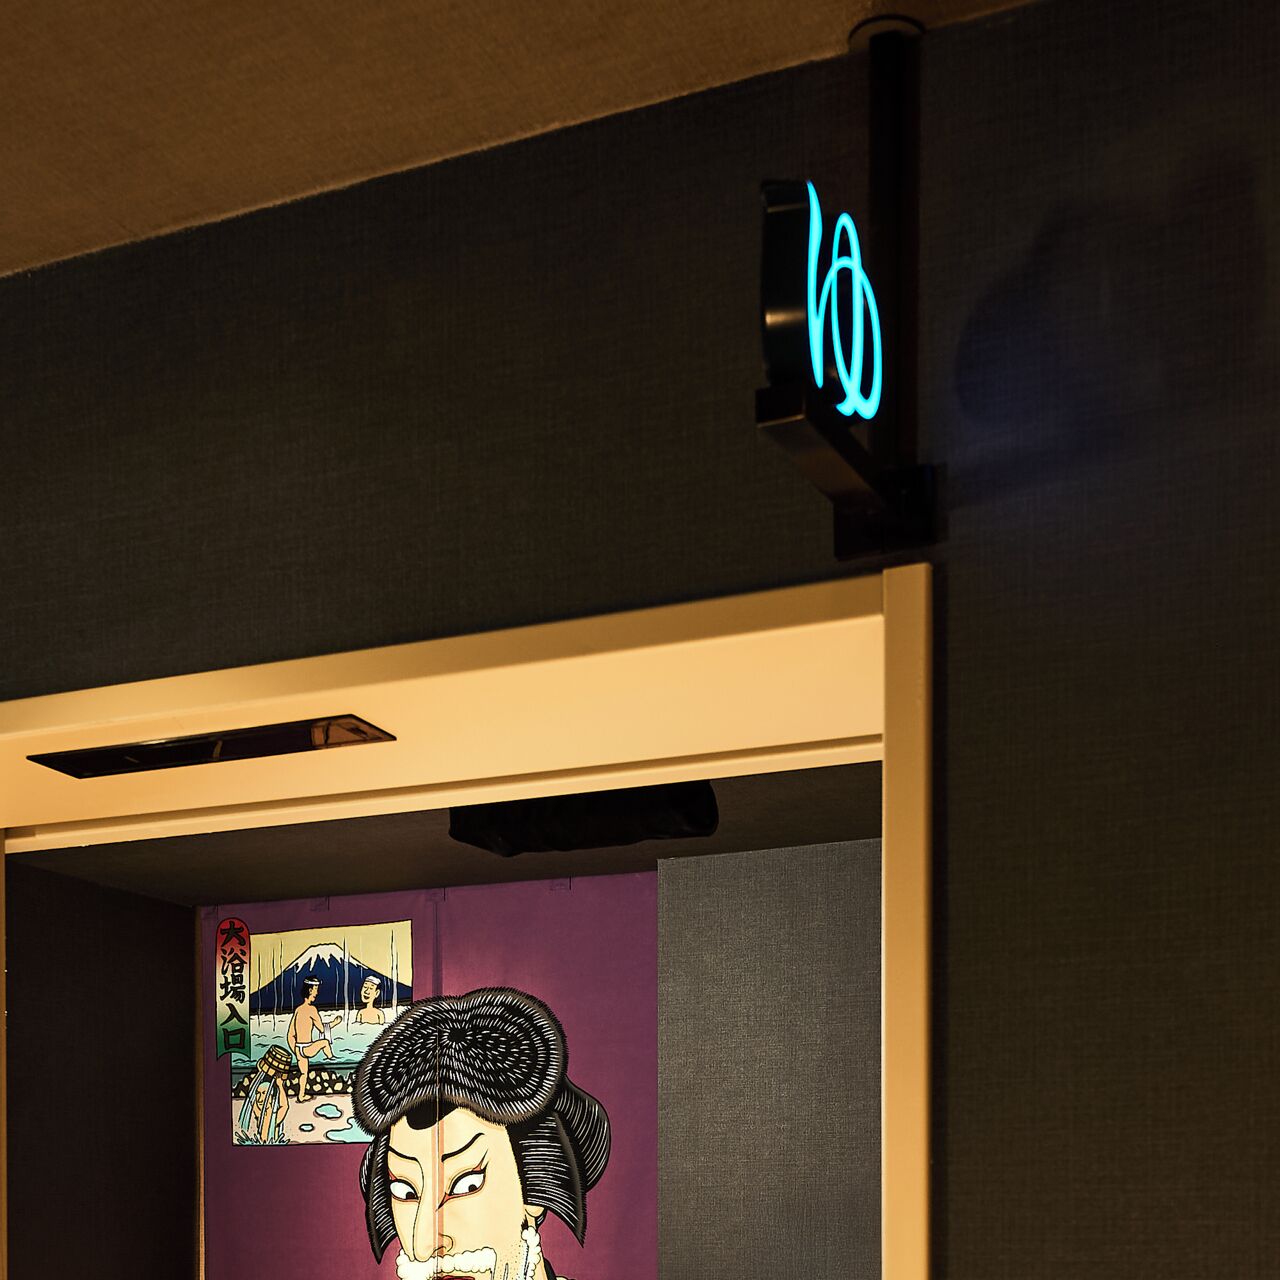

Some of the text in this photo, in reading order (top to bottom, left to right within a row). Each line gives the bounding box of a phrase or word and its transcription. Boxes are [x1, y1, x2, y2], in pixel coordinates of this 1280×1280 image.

[807, 179, 882, 420] ゆ
[220, 922, 249, 1050] 大浴場入口
